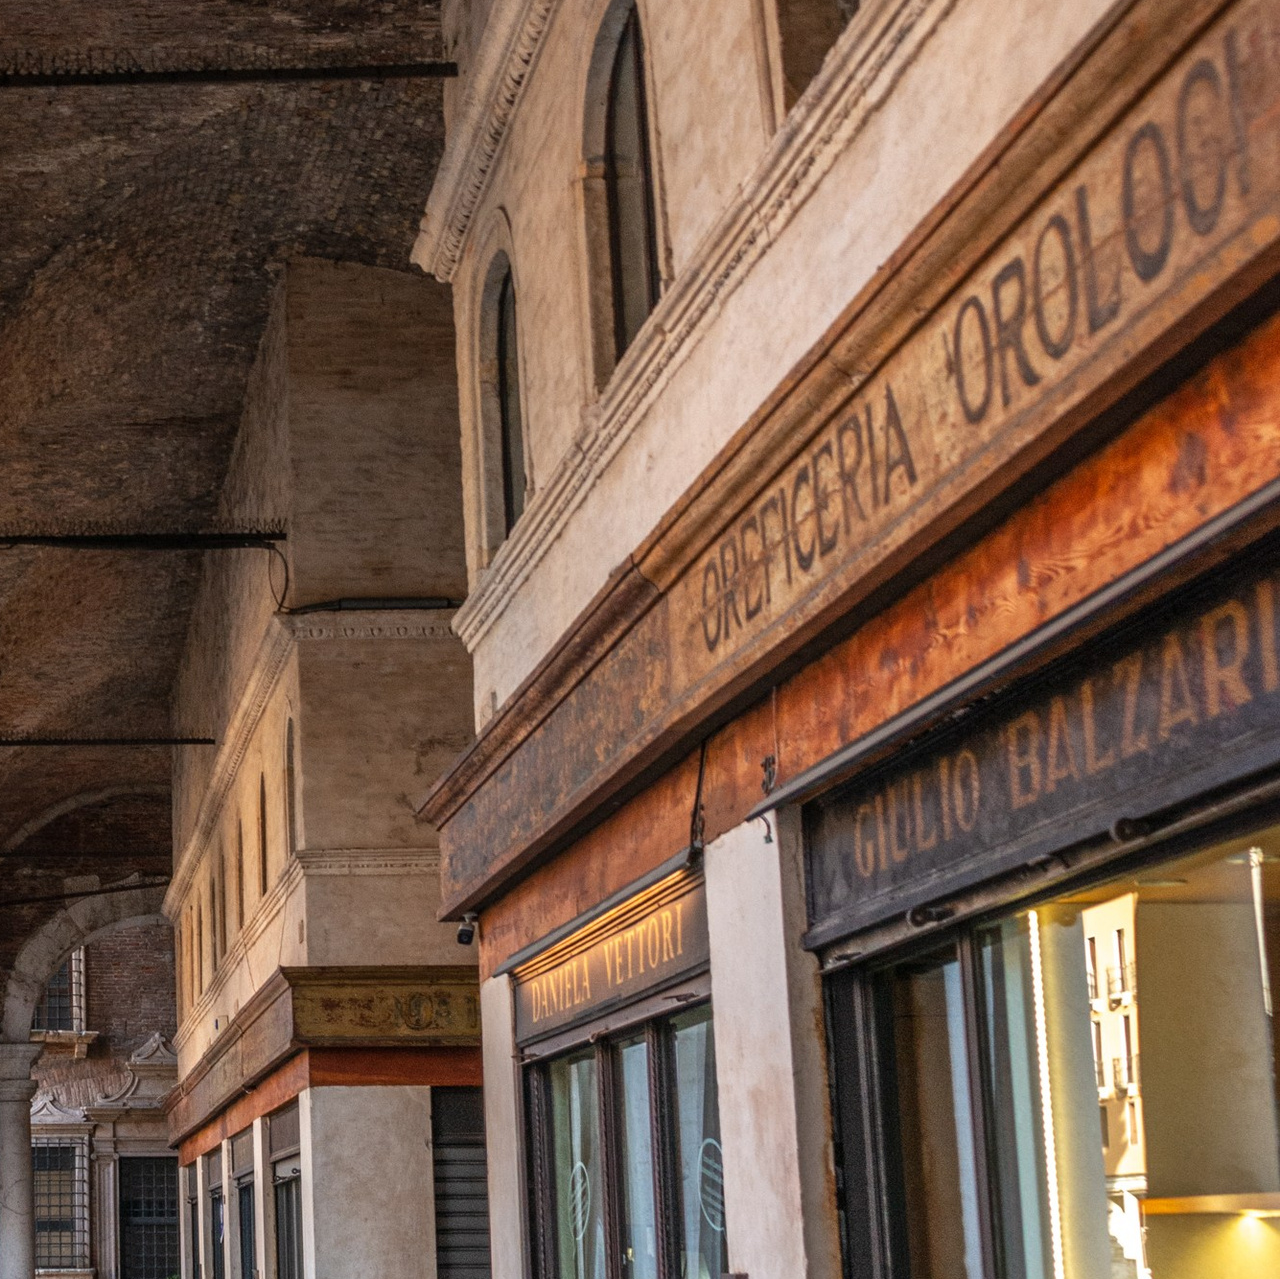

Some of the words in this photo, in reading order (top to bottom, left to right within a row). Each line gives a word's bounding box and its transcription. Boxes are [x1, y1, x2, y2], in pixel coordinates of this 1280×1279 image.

[701, 382, 917, 653] OREFICERIA
[853, 748, 980, 878] GIULIO
[1004, 580, 1279, 810] BALZARI
[531, 954, 591, 1023] DANIELA
[603, 903, 683, 989] VETTORI
